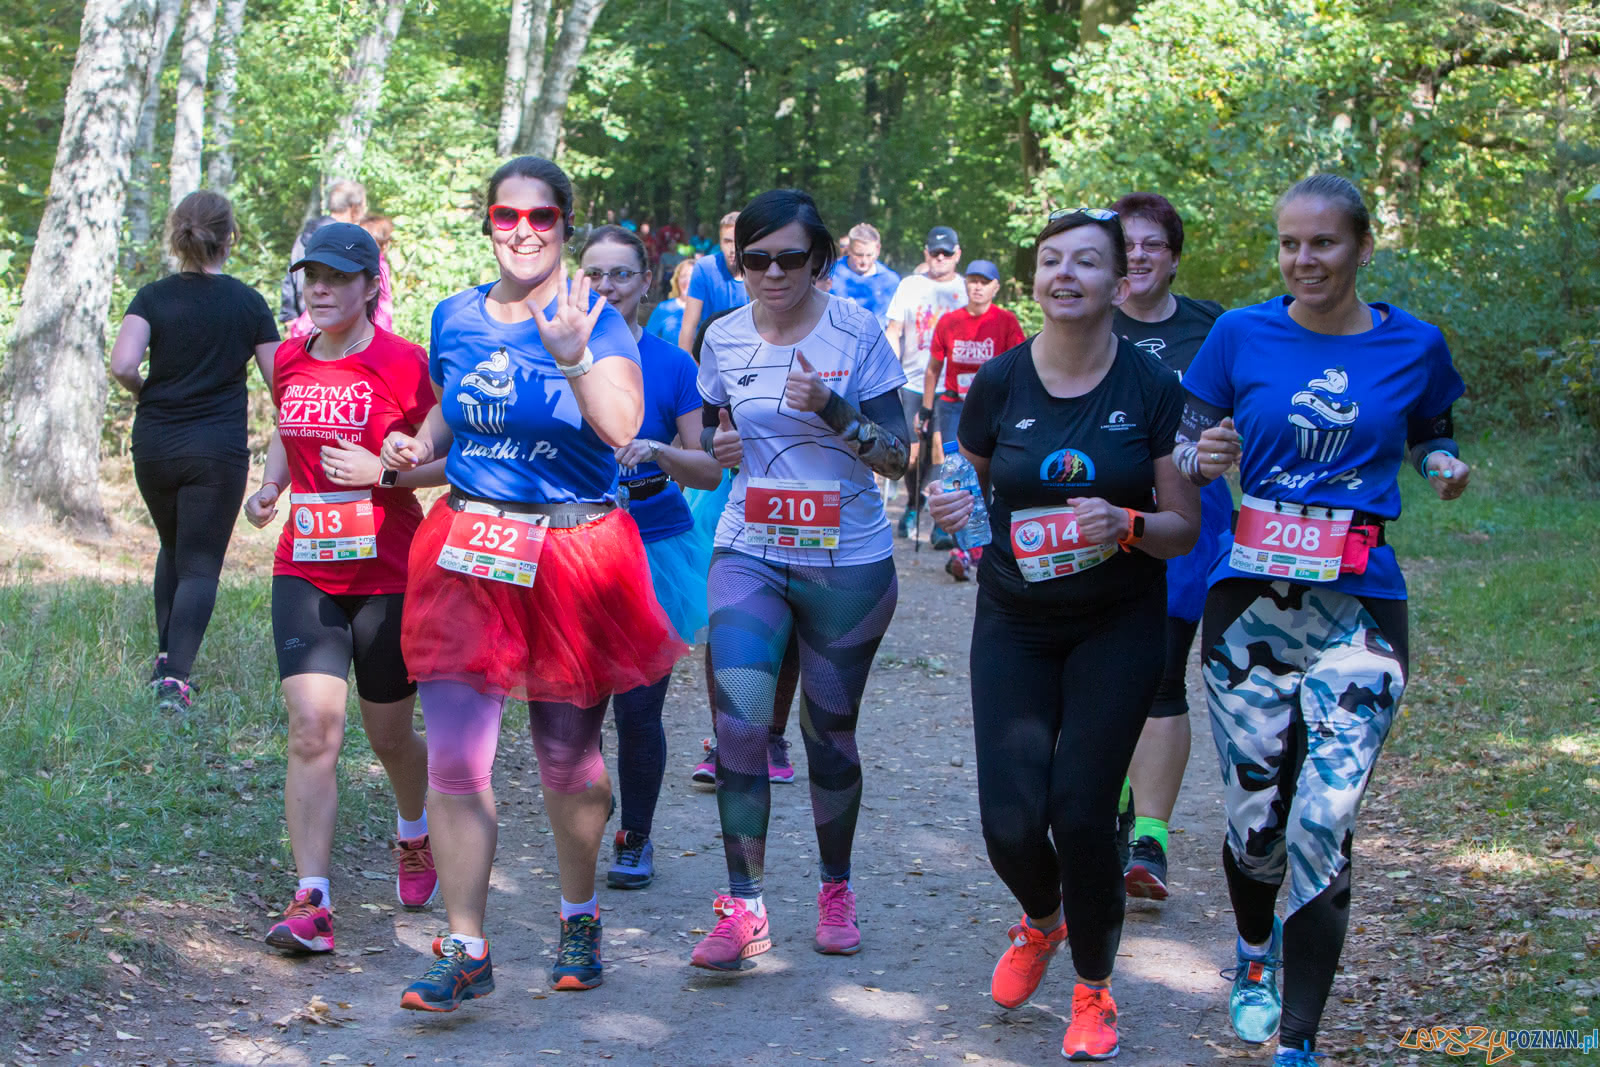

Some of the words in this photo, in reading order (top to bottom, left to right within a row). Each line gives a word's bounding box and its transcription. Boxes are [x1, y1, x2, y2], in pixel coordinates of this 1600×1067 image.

[284, 382, 353, 402] DRUŻYNA
[737, 374, 758, 387] 4F
[280, 400, 372, 427] SZPIKU
[1015, 418, 1036, 430] 4F
[315, 510, 342, 534] 13
[767, 496, 816, 522] 210
[468, 521, 518, 552] 252
[1046, 520, 1080, 548] 14
[1261, 520, 1320, 551] 208
